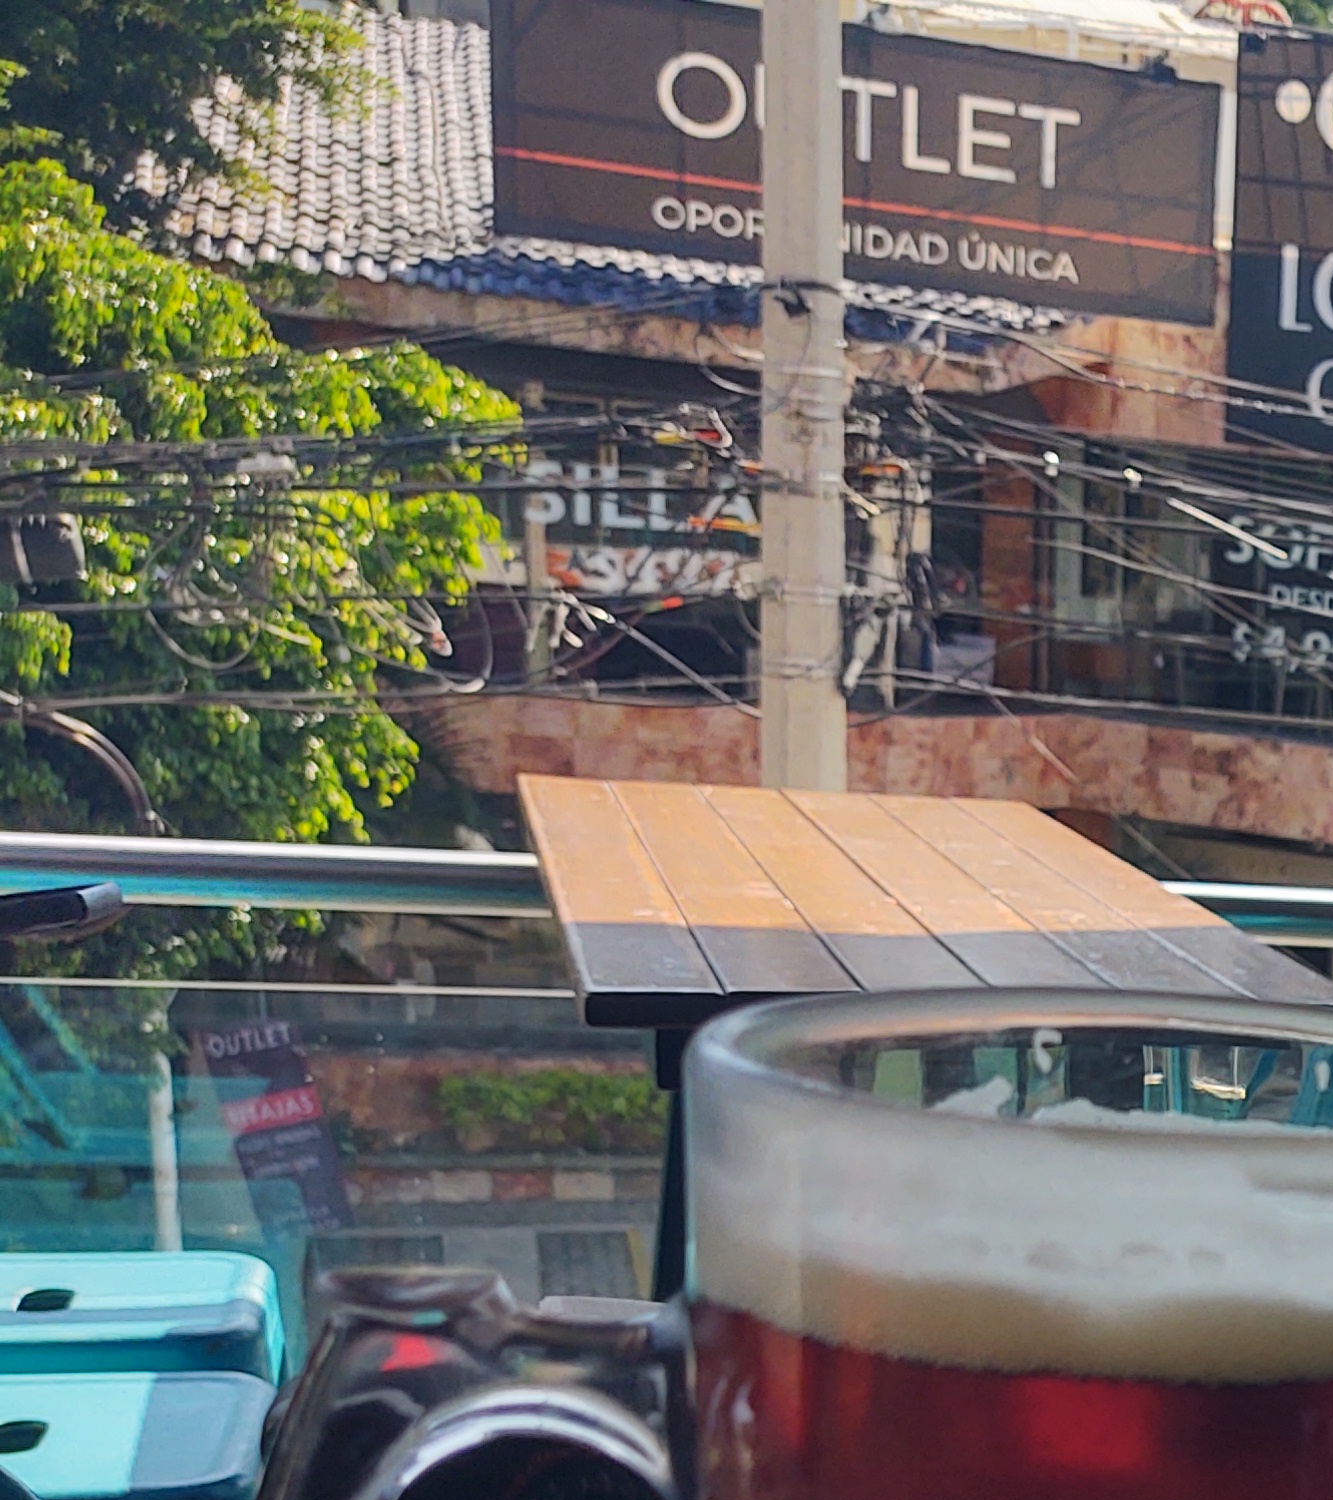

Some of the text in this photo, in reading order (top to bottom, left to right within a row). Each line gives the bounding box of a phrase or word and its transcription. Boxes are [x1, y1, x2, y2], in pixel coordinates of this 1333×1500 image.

[656, 51, 1080, 188] OTLET
[959, 230, 1079, 285] ÚNICA
[204, 1021, 291, 1058] OUTLET
